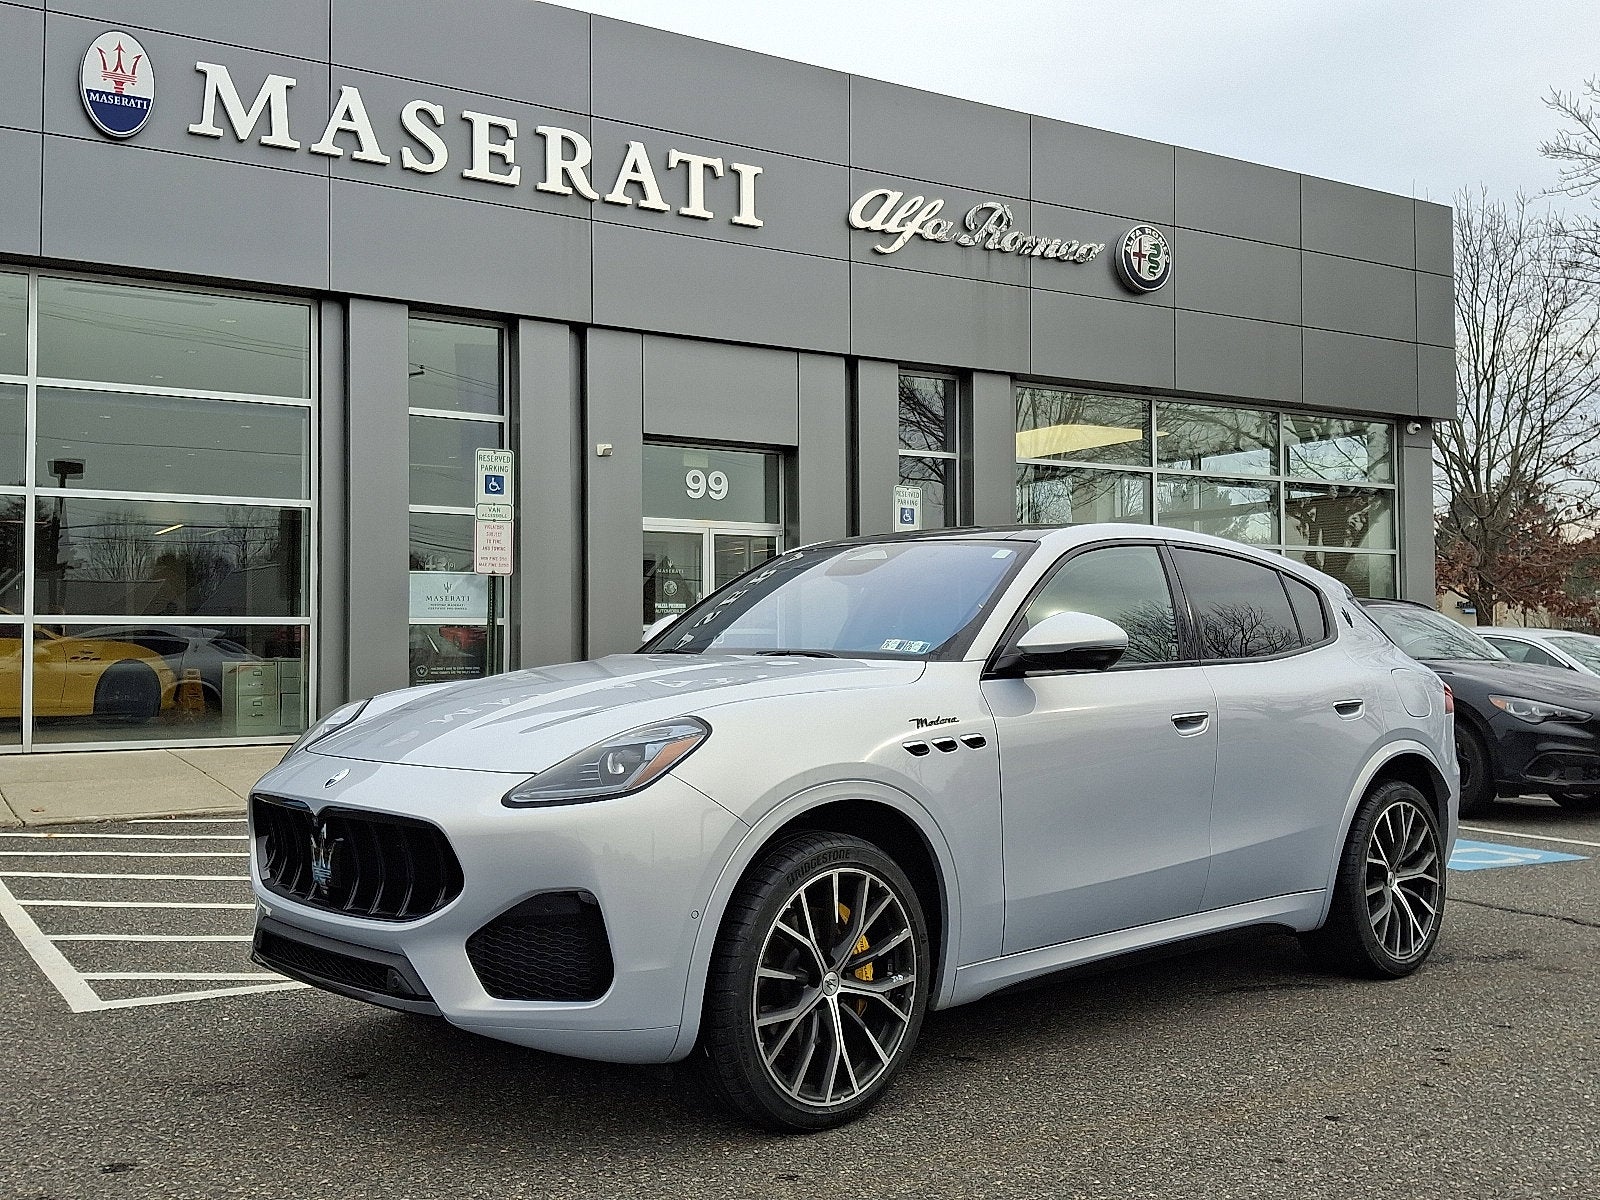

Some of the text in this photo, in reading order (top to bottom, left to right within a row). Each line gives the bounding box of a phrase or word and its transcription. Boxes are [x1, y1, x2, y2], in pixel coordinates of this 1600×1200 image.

[89, 92, 148, 110] MASERATI
[188, 61, 764, 228] MASERATI
[957, 201, 1106, 264] Romeo
[1125, 228, 1170, 264] ALFA ROMEO
[479, 455, 511, 463] RESERVED
[481, 464, 509, 473] PARKING
[685, 469, 729, 500] 99
[896, 490, 920, 498] RESERVED
[897, 498, 918, 506] PARKING
[908, 716, 961, 729] Modena
[786, 849, 850, 886] BRIDGESTONE
